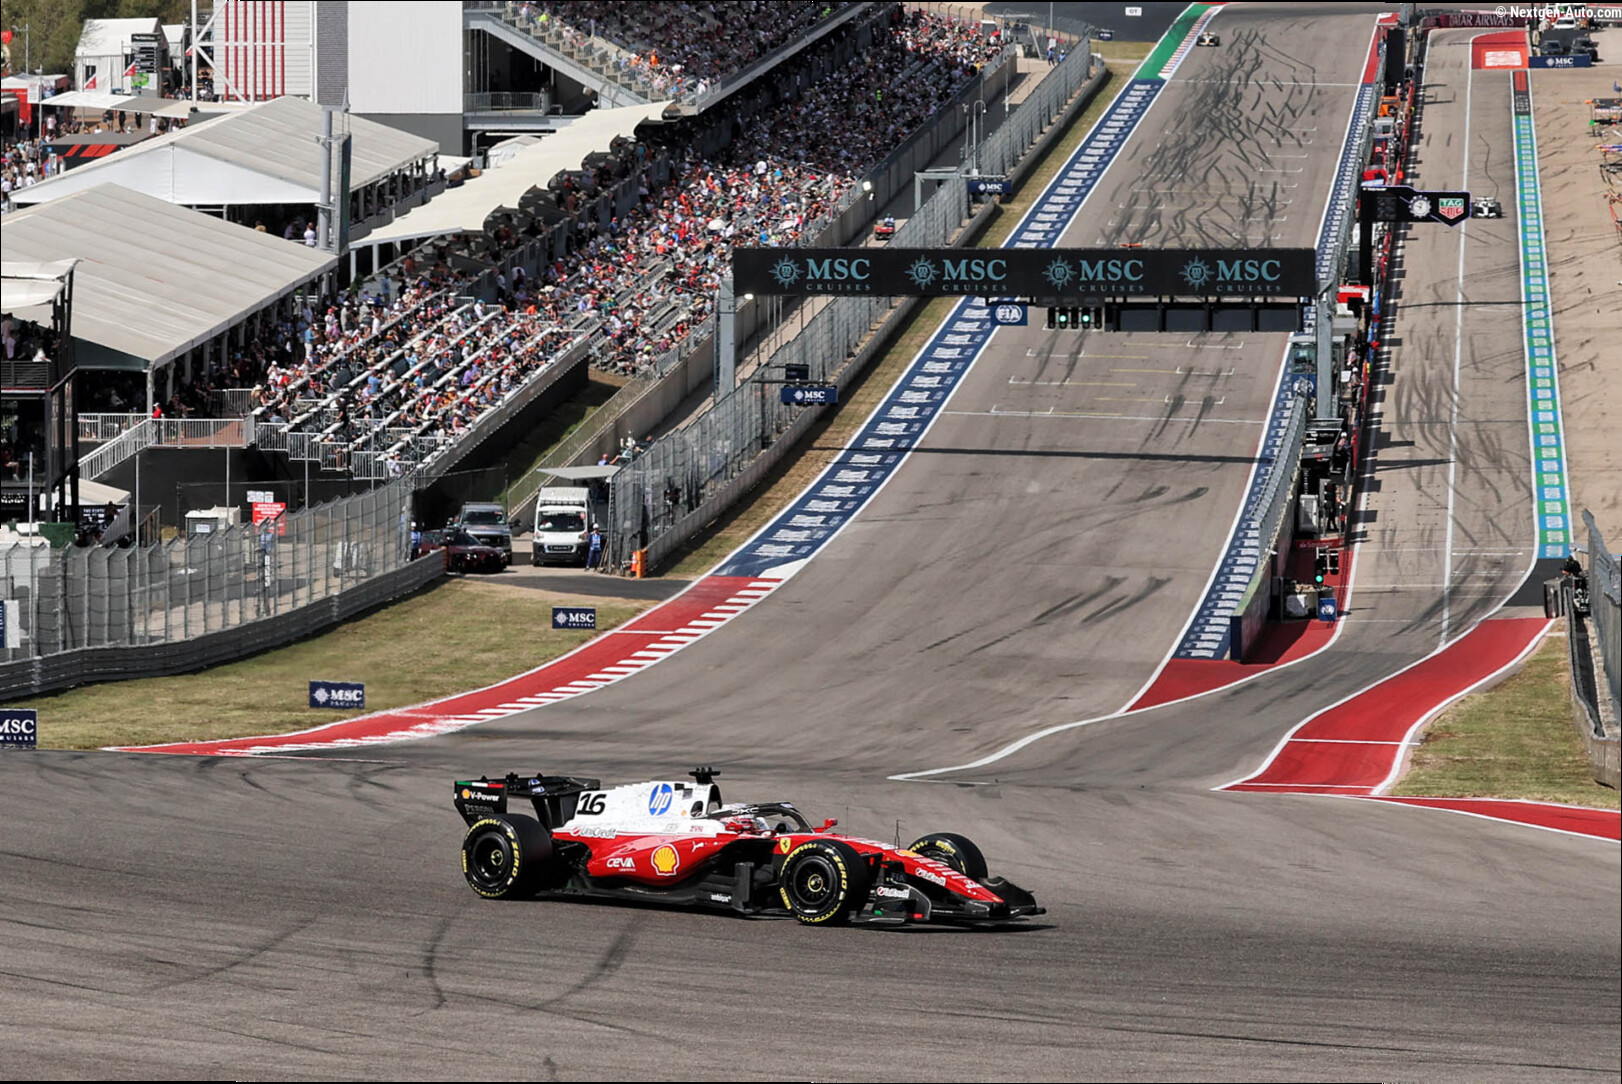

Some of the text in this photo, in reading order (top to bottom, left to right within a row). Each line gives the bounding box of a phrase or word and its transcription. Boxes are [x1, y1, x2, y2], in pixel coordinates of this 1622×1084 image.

[1475, 14, 1515, 26] AIRWAYS
[1440, 199, 1464, 207] TAG
[806, 258, 871, 279] MSC
[942, 259, 1007, 280] MSC
[1079, 260, 1144, 281] MSC
[1216, 260, 1281, 281] MSC
[806, 283, 871, 291] CRUISES
[942, 284, 1007, 292] CRUISES
[1079, 284, 1144, 292] CRUISES
[1216, 284, 1281, 292] CRUISES
[804, 390, 825, 399] MSC
[569, 613, 595, 623] MSC
[330, 689, 363, 702] MSC
[0, 719, 35, 734] MSC
[470, 791, 500, 802] V-Power
[650, 784, 672, 816] hp
[577, 793, 607, 815] 16
[580, 826, 616, 838] UniCredit
[511, 841, 520, 877] ZERO
[832, 855, 848, 890] ZERO
